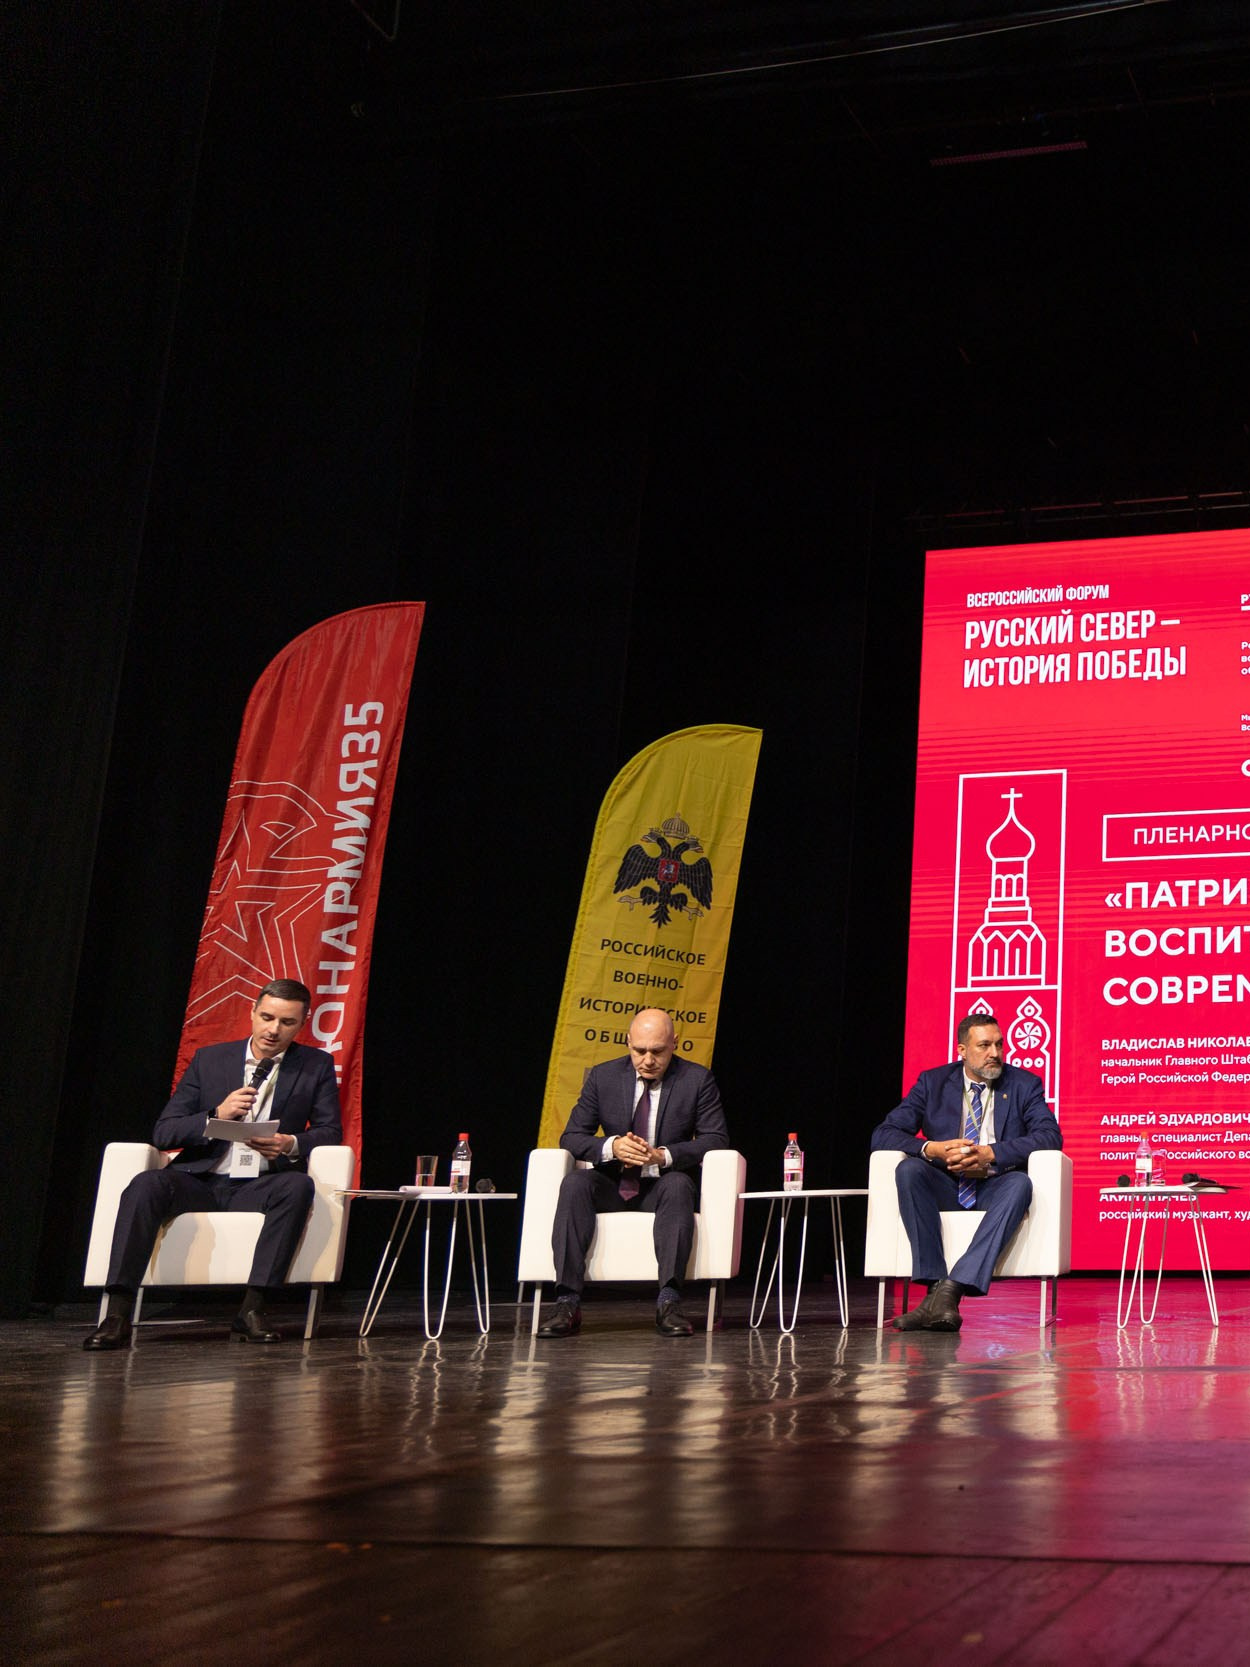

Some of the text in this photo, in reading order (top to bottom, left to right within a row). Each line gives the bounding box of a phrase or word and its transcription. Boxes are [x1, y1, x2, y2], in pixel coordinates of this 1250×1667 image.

[966, 584, 1110, 608] ВСЕРОССИЙСКИЙ ФОРУМ
[964, 608, 1074, 650] РУССКИЙ
[1080, 609, 1156, 643] СЕВЕР
[963, 646, 1187, 689] ИСТОРИЯ ПОБЕДЫ
[311, 700, 385, 1085] ЮНАРМИЯ35
[600, 938, 707, 966] РОССИЙСКОЕ
[613, 970, 684, 991] ВОЕННО-
[579, 997, 707, 1024] ИСТОРСКОЕ
[584, 1029, 694, 1052] ОБЩО
[1101, 1037, 1185, 1052] ВЛАДИСЛАВ
[1101, 1058, 1163, 1067] начальник
[1165, 1054, 1219, 1066] Главного
[1101, 1072, 1136, 1087] Герой
[1138, 1071, 1209, 1084] Российской
[1100, 1111, 1156, 1128] АНДРЕЙ
[1100, 1134, 1146, 1144] главны
[1151, 1133, 1222, 1144] специалист
[1099, 1208, 1170, 1221] российский
[1172, 1210, 1232, 1221] музыкант,
